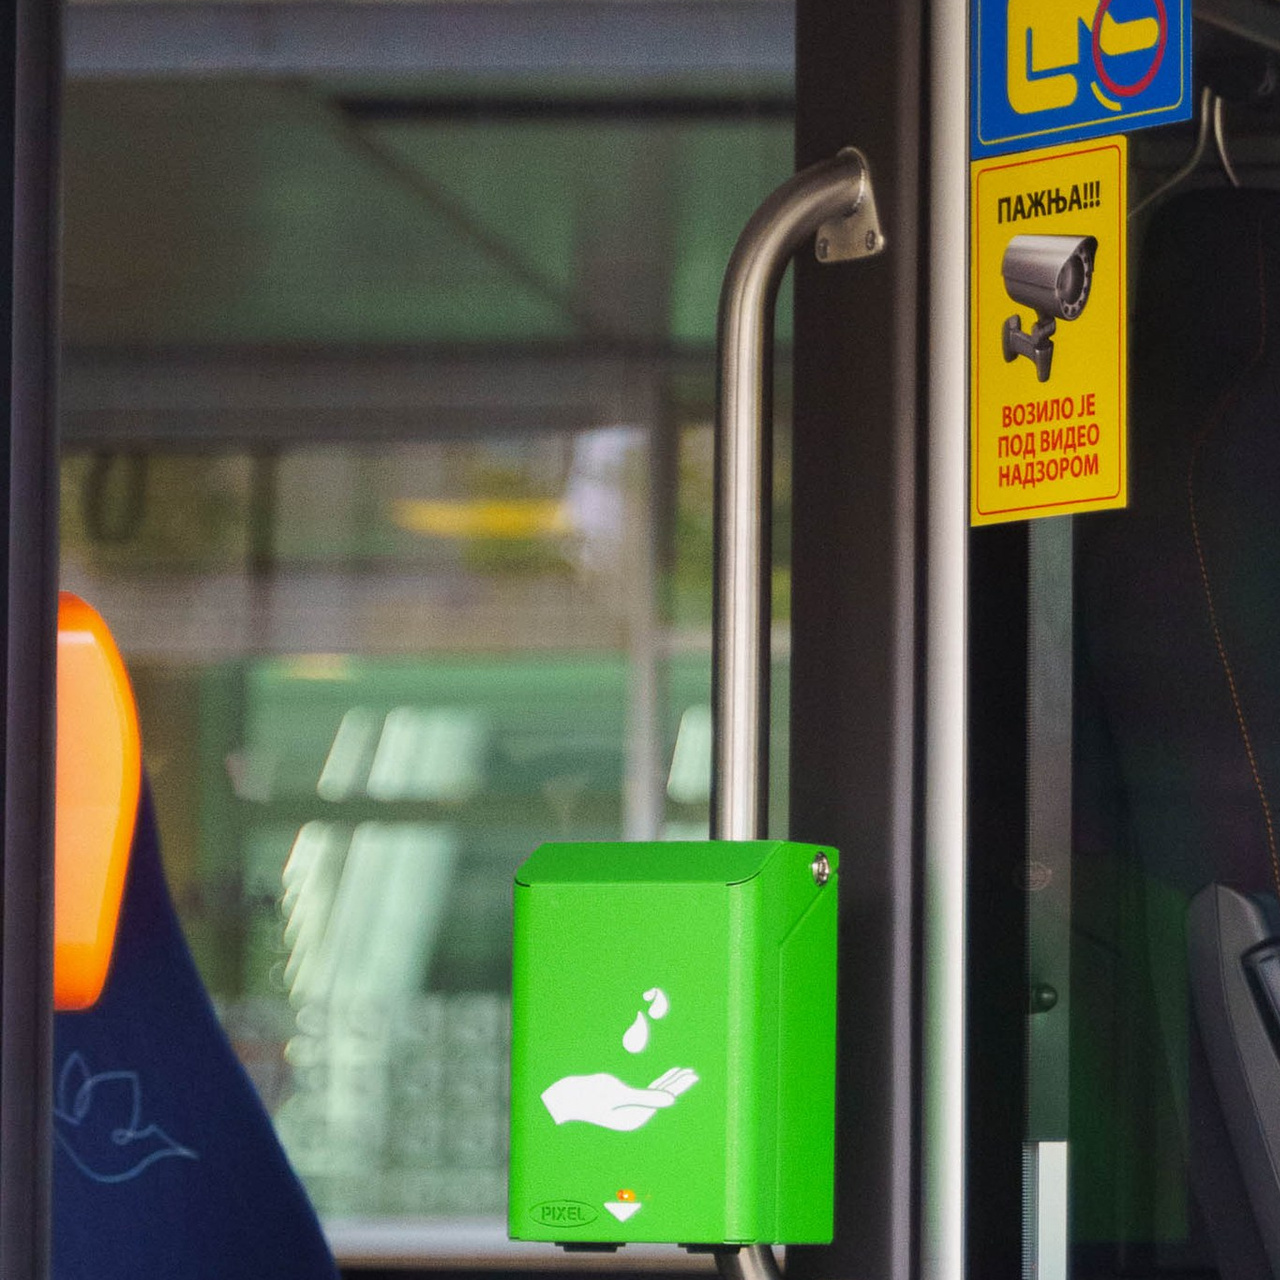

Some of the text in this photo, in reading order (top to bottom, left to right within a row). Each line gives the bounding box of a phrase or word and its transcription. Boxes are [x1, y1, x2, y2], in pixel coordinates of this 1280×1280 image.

[998, 181, 1101, 224] ПАЖЊА!!!
[1002, 393, 1096, 428] ВОЗИЛО ЈЕ
[998, 423, 1100, 460] ПОД ВИДЕО
[999, 453, 1099, 489] НАДЗОРОМ
[541, 1206, 586, 1221] PIXEL
